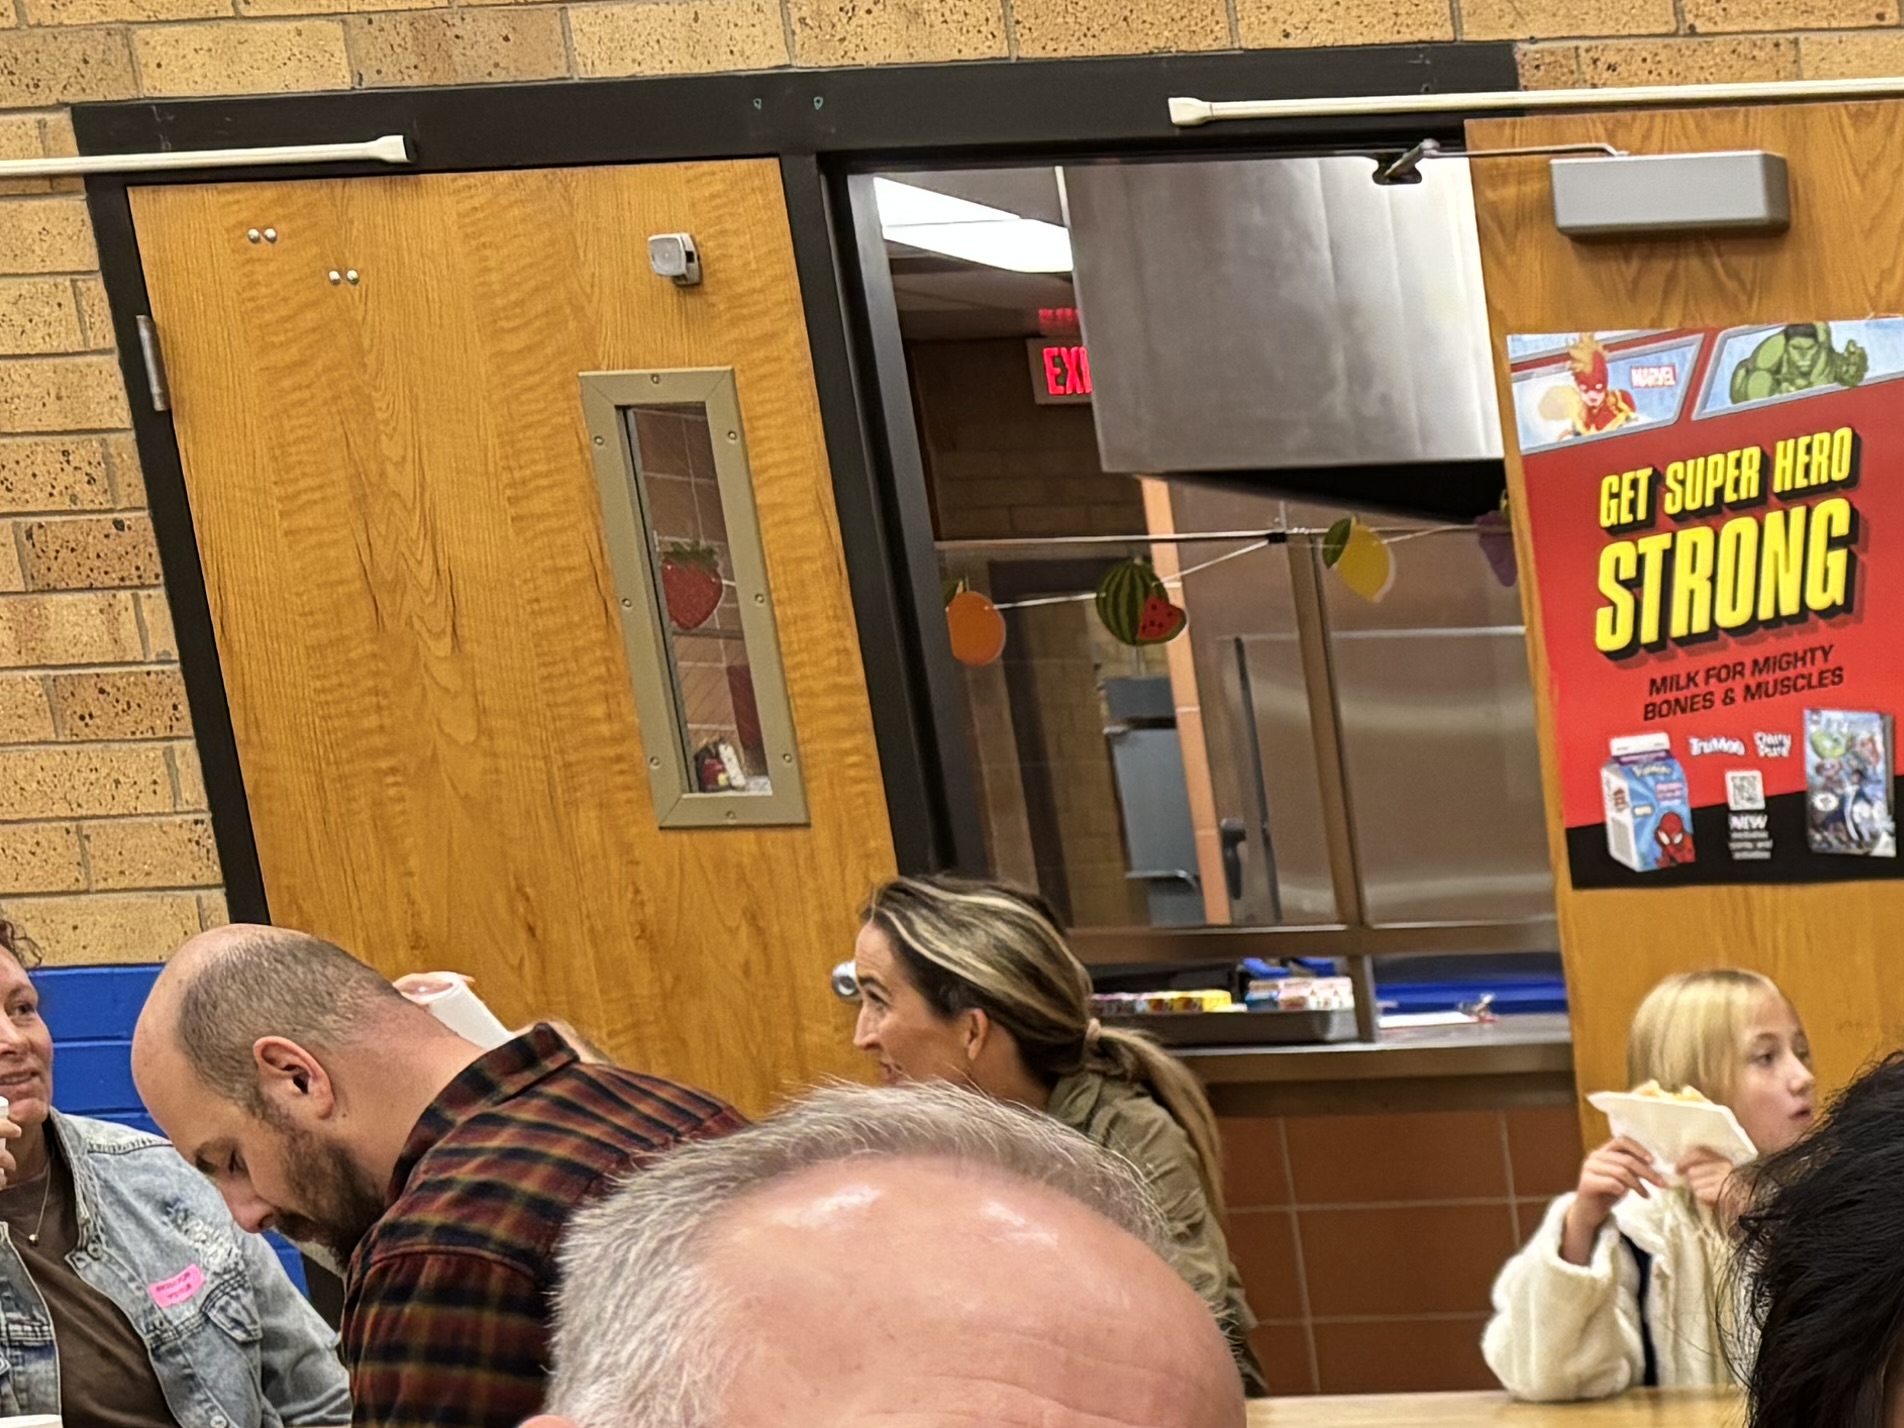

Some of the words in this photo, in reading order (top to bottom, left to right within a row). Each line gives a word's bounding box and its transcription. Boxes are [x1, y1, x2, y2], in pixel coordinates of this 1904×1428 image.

[1042, 346, 1093, 395] EXI
[1630, 366, 1677, 388] MARVEL
[1600, 466, 1653, 528] GET
[1663, 445, 1762, 516] SUPER
[1772, 426, 1854, 494] HERO
[1594, 497, 1852, 653] STRONG
[1643, 690, 1716, 722] BONES
[1720, 687, 1737, 707] &
[1743, 667, 1845, 703] MUSCLES
[1649, 669, 1702, 697] MILK
[1704, 661, 1748, 687] FOR
[1751, 645, 1835, 677] MIGHTY
